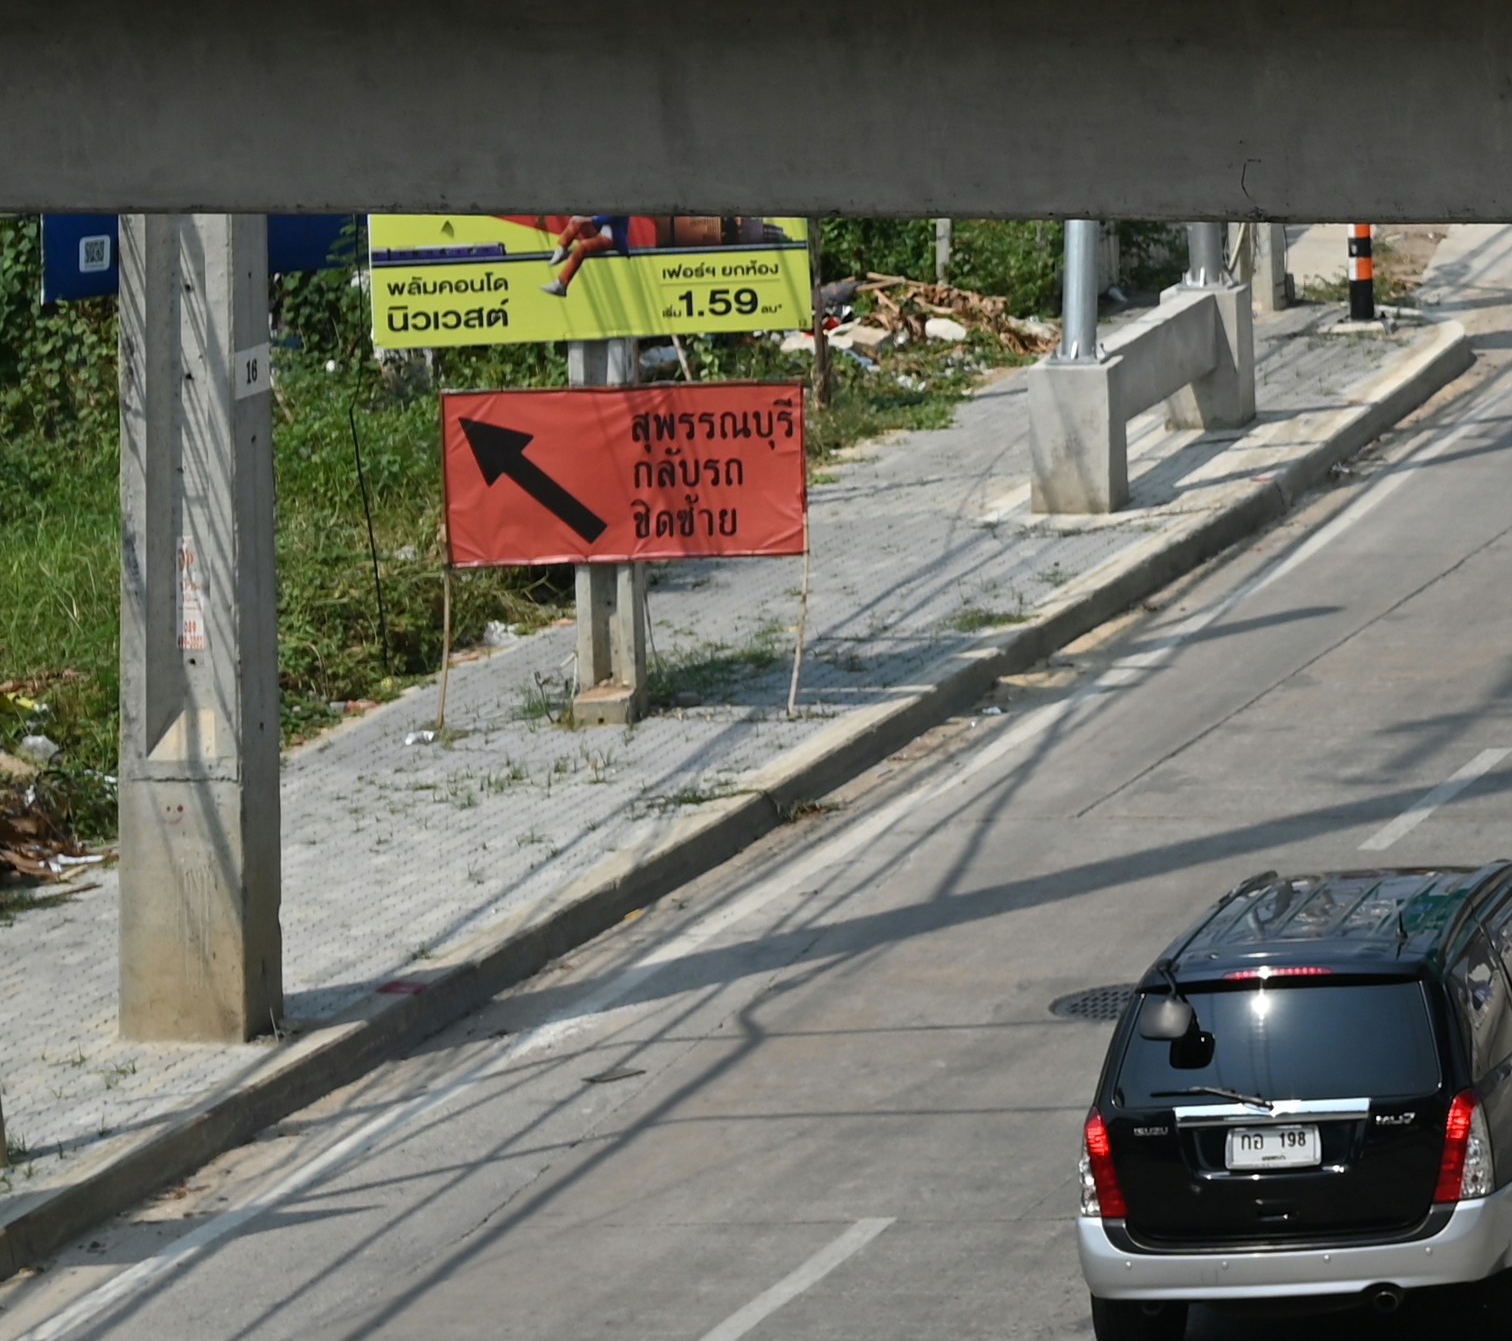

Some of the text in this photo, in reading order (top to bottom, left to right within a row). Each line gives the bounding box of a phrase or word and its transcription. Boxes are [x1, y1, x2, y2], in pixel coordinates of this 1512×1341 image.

[721, 259, 779, 278] ยกห้อง
[387, 272, 509, 296] พลัมคอนโด
[387, 299, 509, 332] นิวเวสต์
[678, 288, 759, 317] 1.59
[245, 358, 258, 384] 16
[631, 398, 794, 453] สุพรรณบุรี
[633, 447, 743, 488] กลับรถ
[631, 494, 738, 539] ชิดซ้าย
[1279, 1131, 1306, 1148] 198
